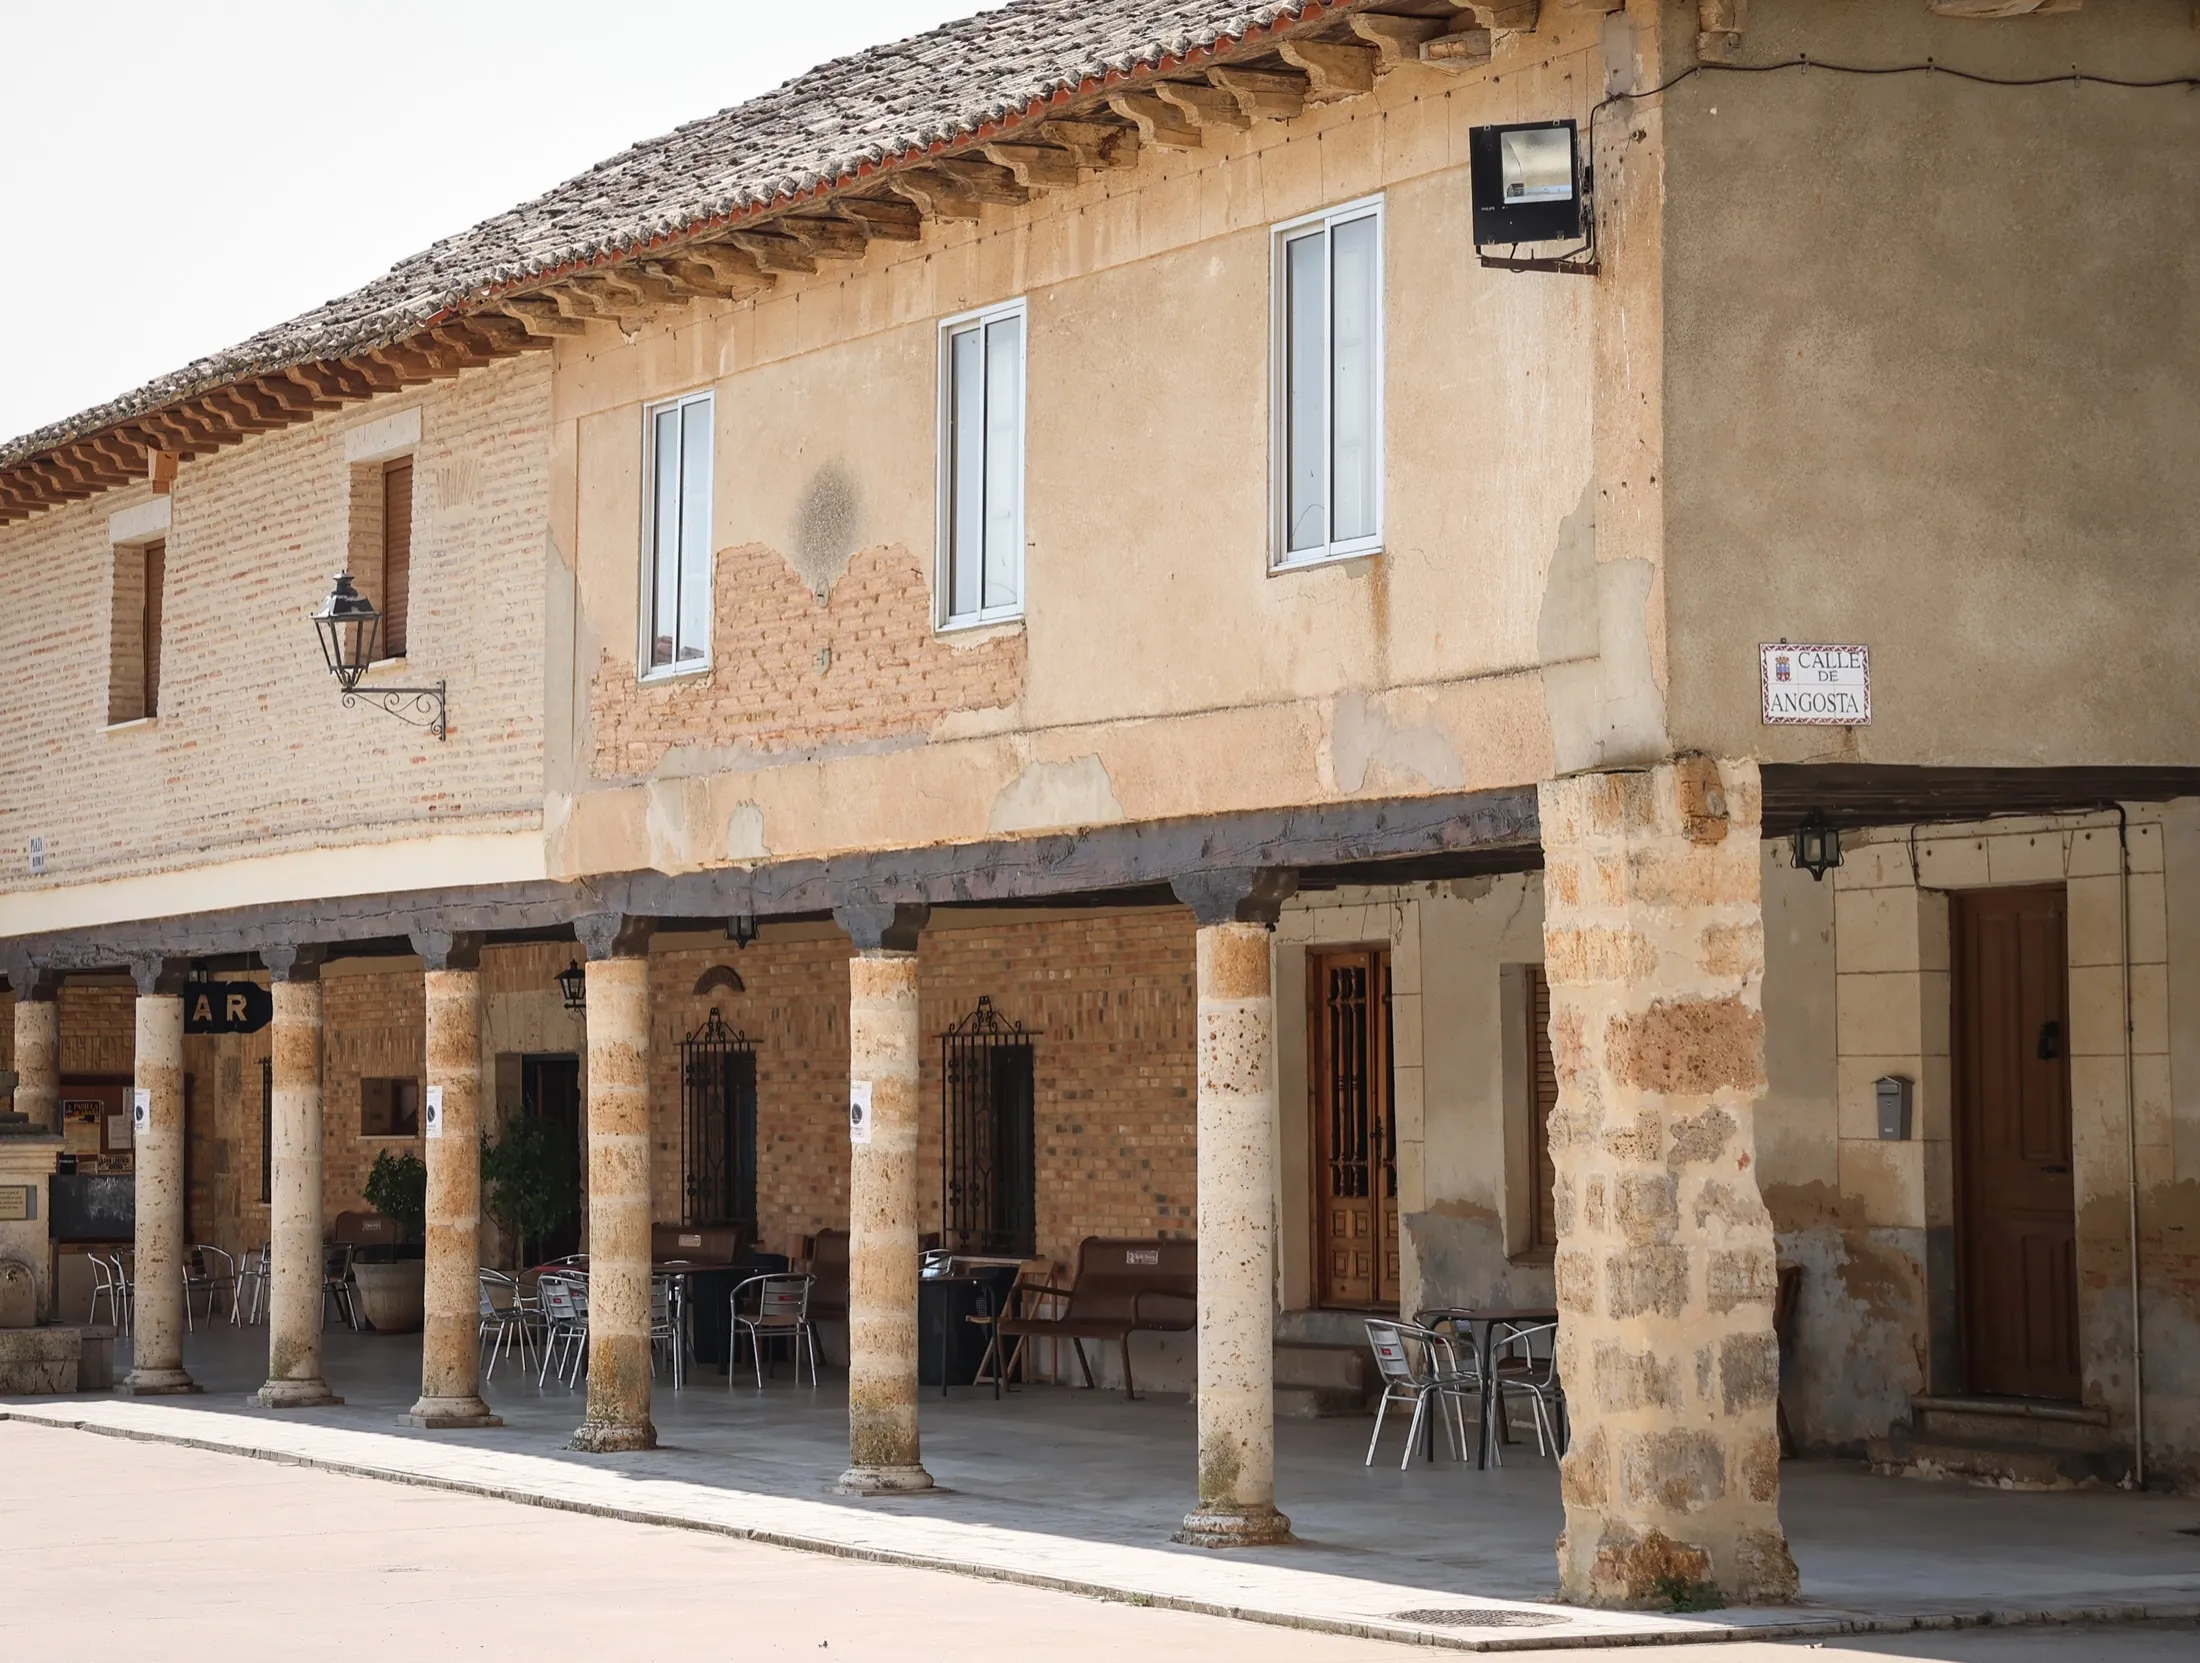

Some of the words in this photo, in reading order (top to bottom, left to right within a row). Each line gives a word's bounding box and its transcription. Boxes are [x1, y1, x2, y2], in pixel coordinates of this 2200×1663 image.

[1798, 652, 1861, 668] CALLE
[1818, 670, 1839, 682] DE
[1771, 692, 1859, 713] ANGOSTA
[192, 993, 247, 1022] AR
